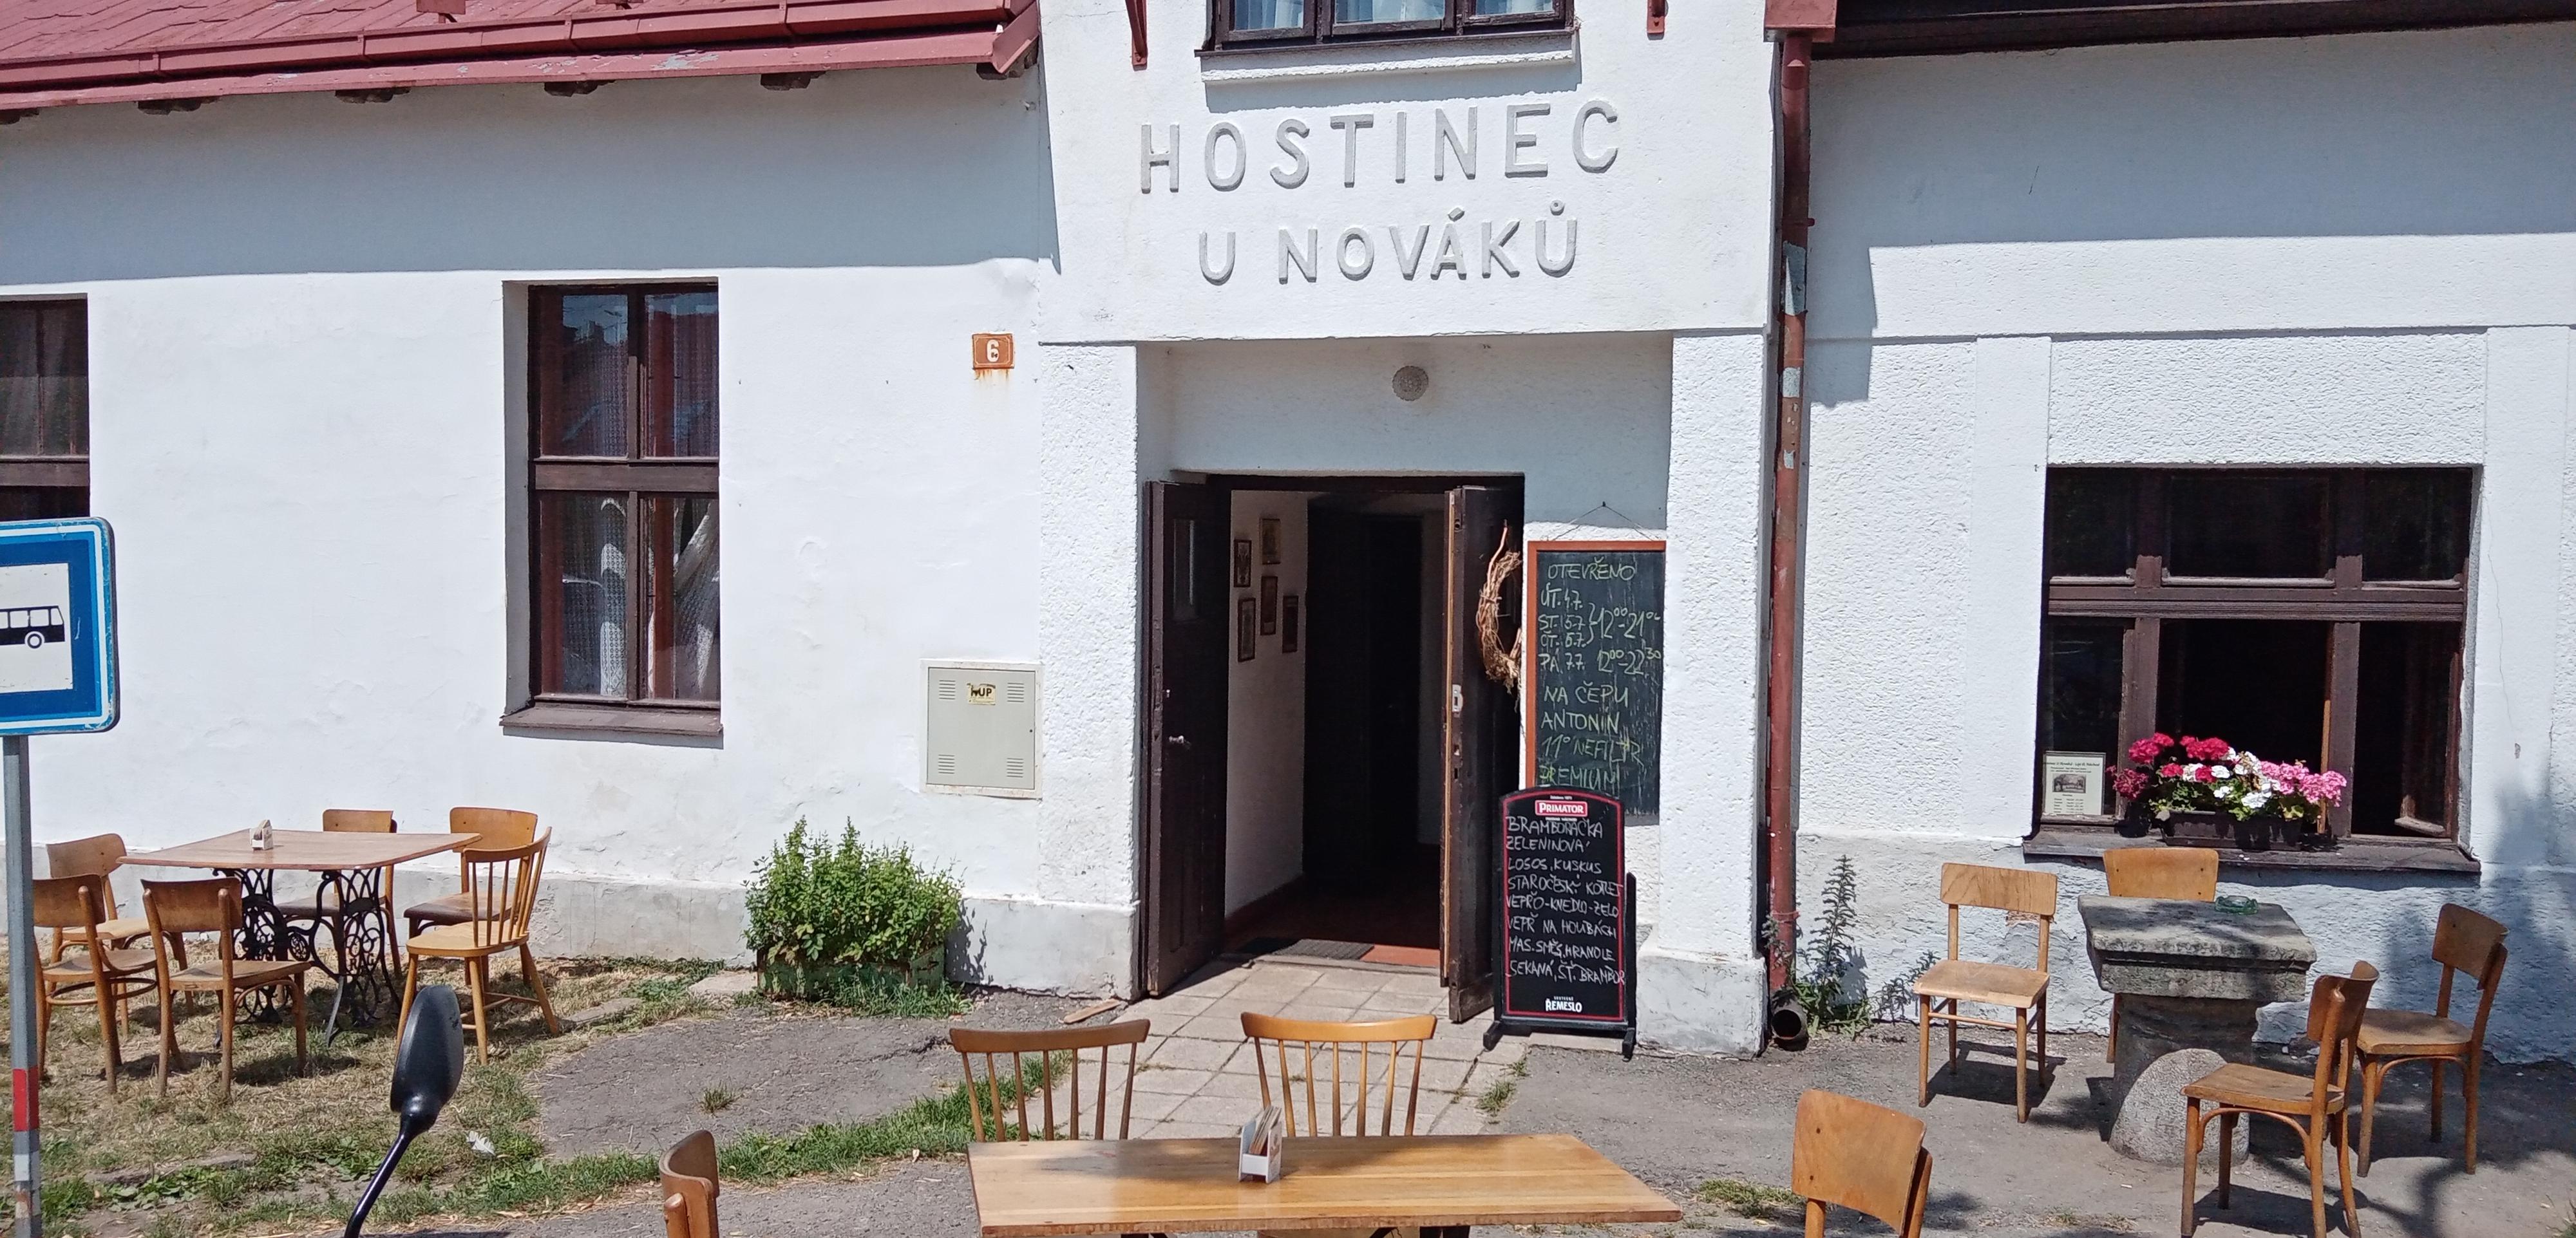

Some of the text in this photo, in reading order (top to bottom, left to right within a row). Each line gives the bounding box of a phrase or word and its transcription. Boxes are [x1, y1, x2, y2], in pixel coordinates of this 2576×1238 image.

[1141, 99, 1619, 194] HOSTINEC
[1198, 198, 1578, 286] U NOVÁKŮ
[986, 339, 1000, 362] 6
[1548, 556, 1637, 581] OTEVŘENO
[1540, 582, 1562, 609] ÚT.
[1538, 614, 1559, 631] ST.
[1544, 680, 1629, 708] NA ČEPU
[1539, 802, 1584, 814] PRIMATOR
[1505, 815, 1603, 839] BRAMBORAČKA
[1508, 912, 1616, 939] VEPŘ NA HOUBÁCH
